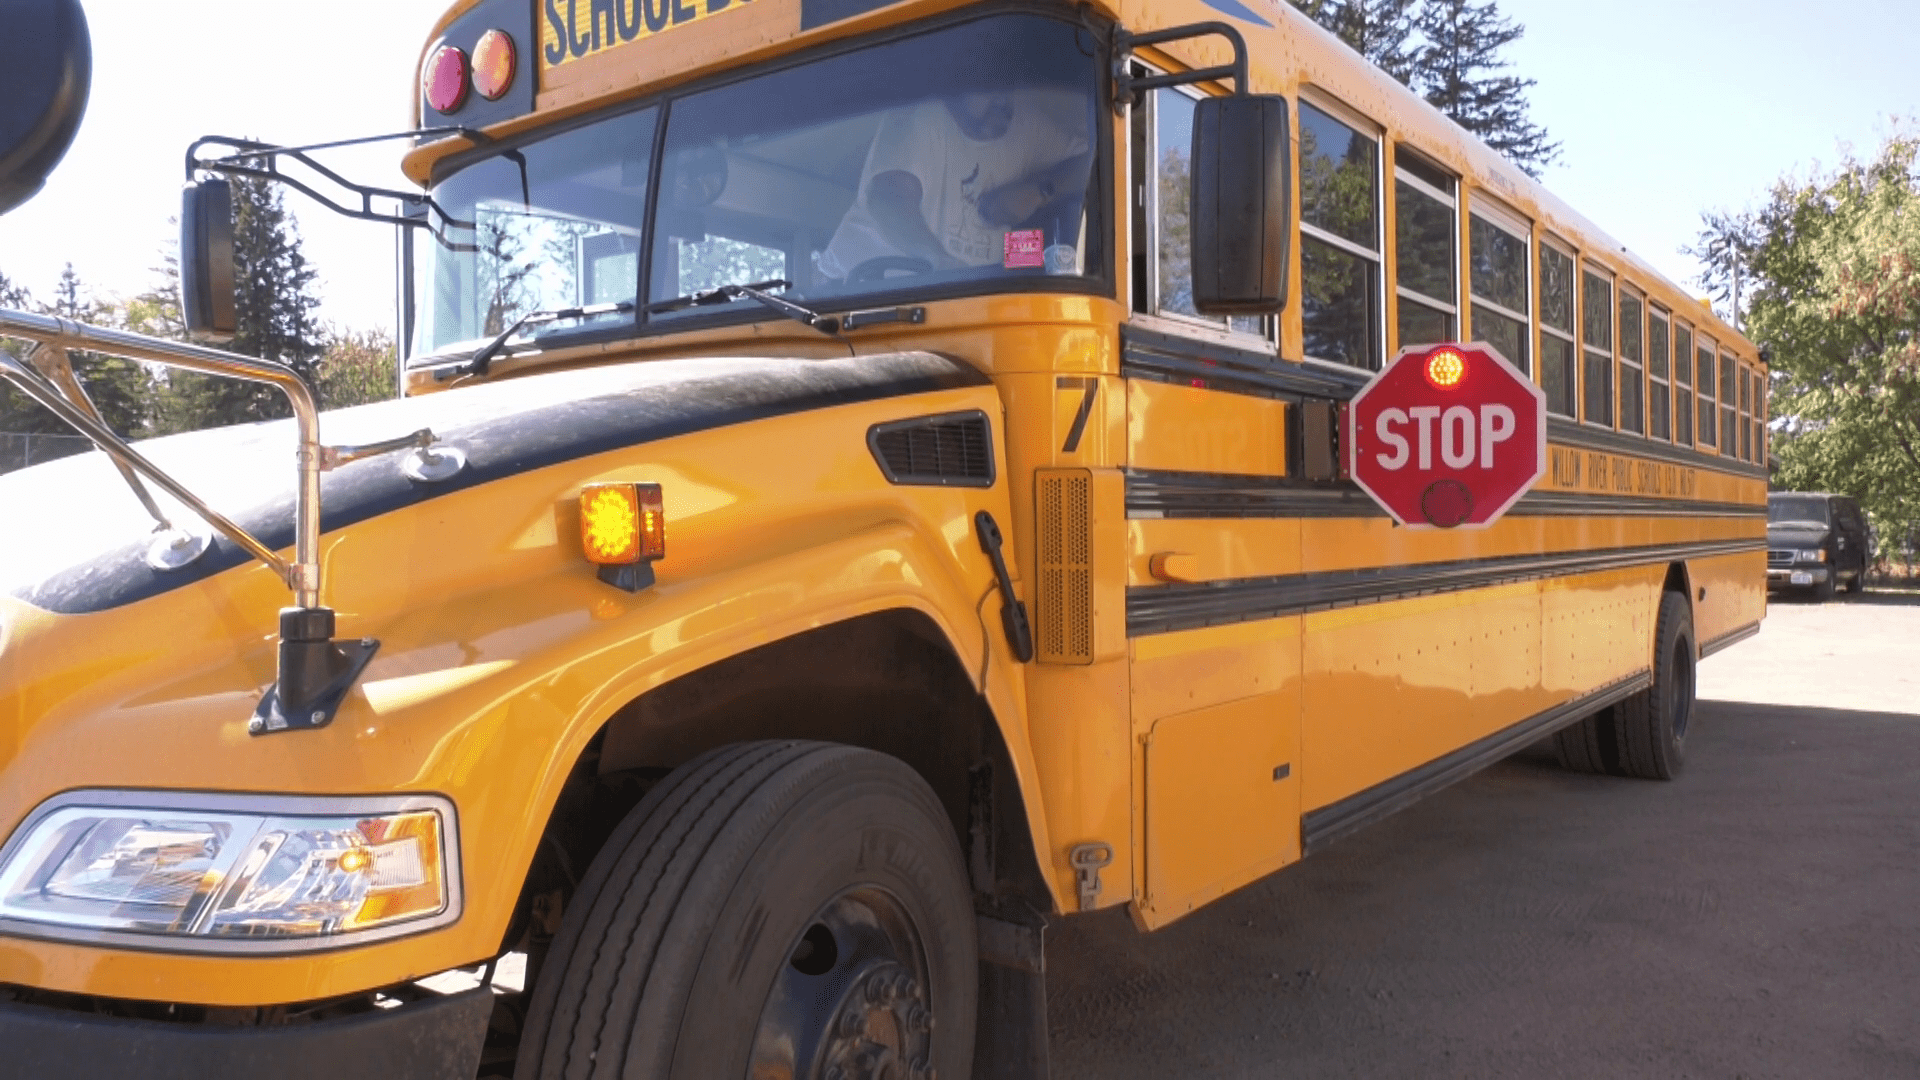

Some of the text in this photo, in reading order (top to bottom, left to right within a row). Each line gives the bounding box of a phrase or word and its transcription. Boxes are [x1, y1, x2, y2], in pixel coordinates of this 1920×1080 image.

[1056, 376, 1098, 452] 7
[1376, 403, 1516, 470] STOP
[1552, 447, 1581, 488] WILLOW
[1588, 452, 1607, 489] RIVER
[1612, 456, 1633, 492] PUBLIC
